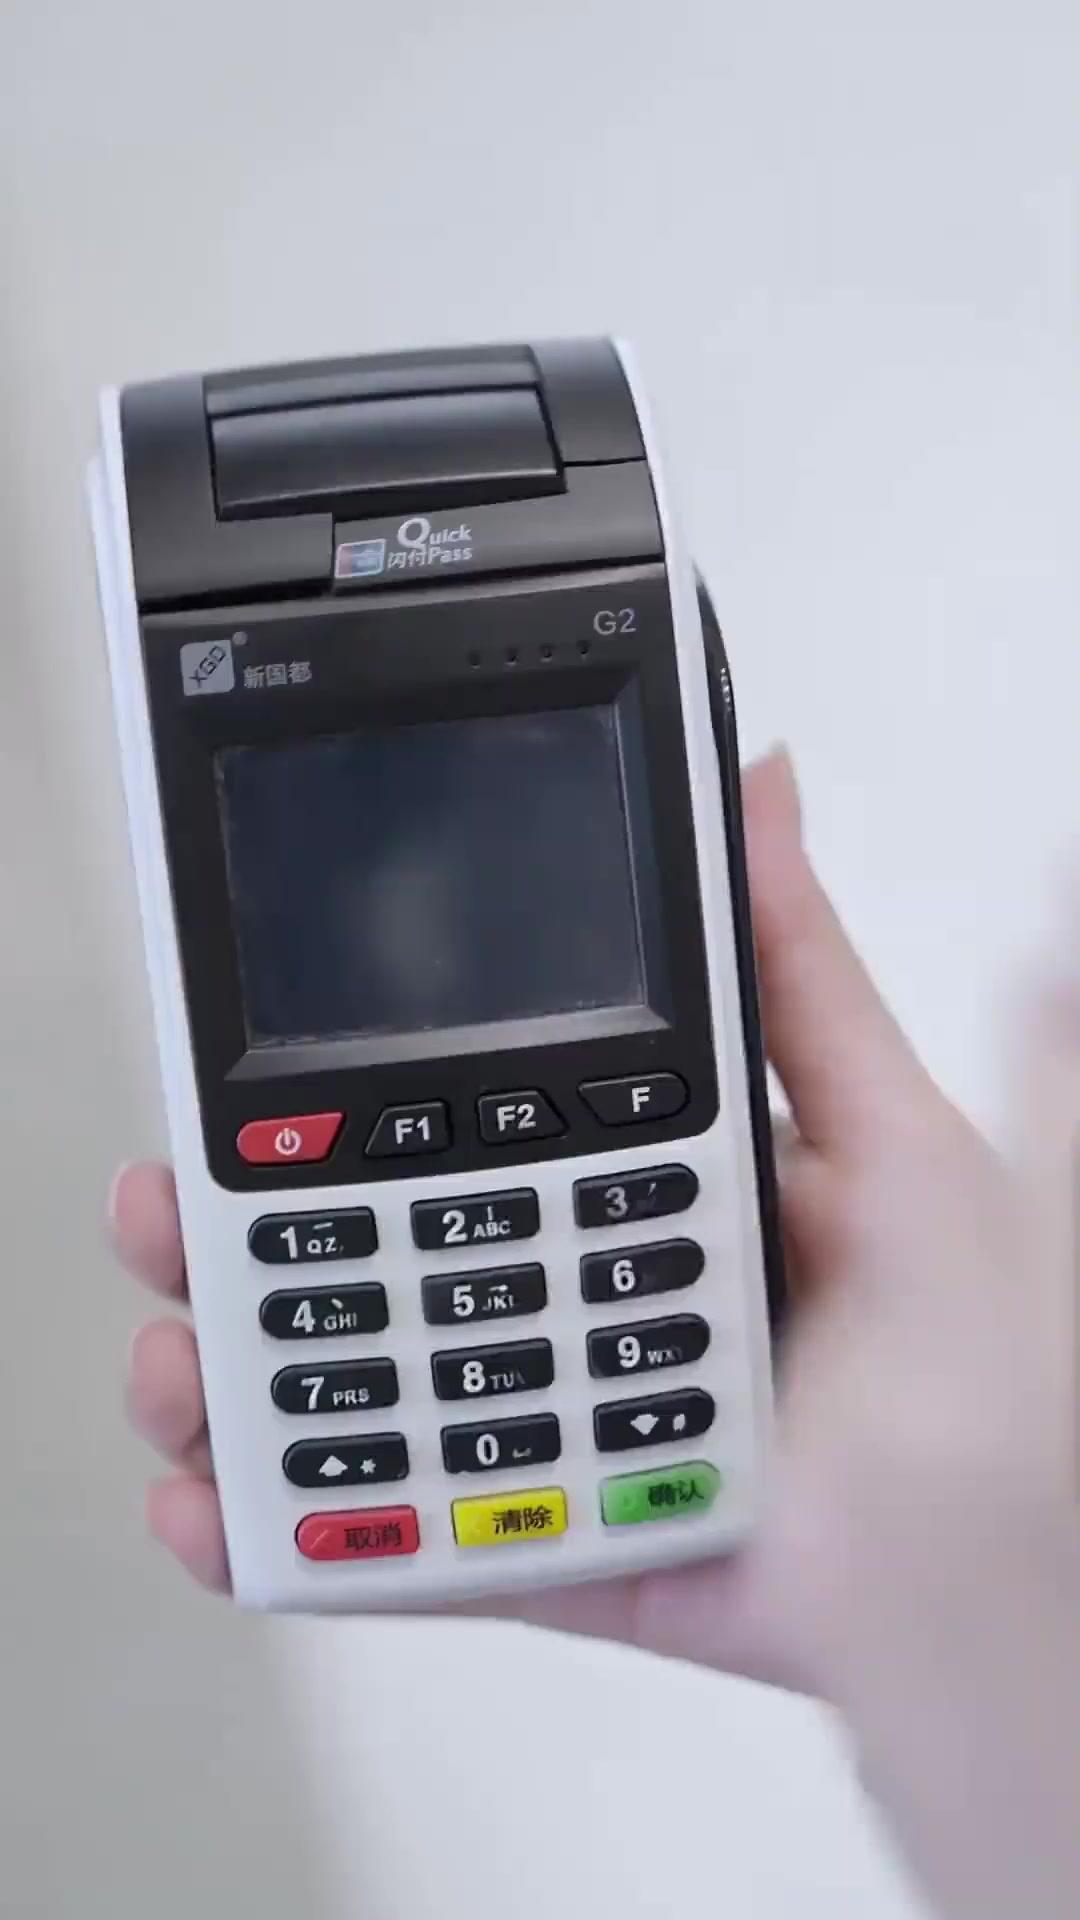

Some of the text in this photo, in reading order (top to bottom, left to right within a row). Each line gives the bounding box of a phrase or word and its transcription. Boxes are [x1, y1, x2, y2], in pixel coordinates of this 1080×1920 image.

[397, 517, 472, 551] Quick
[427, 547, 472, 564] Pass
[593, 607, 636, 635] G2
[243, 660, 312, 689] 新国都
[631, 1086, 650, 1113] F
[394, 1116, 430, 1144] F1
[497, 1103, 536, 1131] F2
[605, 1186, 629, 1218] 3
[279, 1225, 298, 1260] 1
[442, 1209, 511, 1243] 2 ABC
[612, 1259, 636, 1292] 6
[292, 1299, 357, 1332] 4 GHI
[453, 1284, 475, 1317] 5
[617, 1335, 641, 1368] 9
[301, 1376, 370, 1410] 7 PRS
[462, 1360, 486, 1393] 8
[476, 1433, 499, 1466] 0
[492, 1505, 554, 1534] 清除
